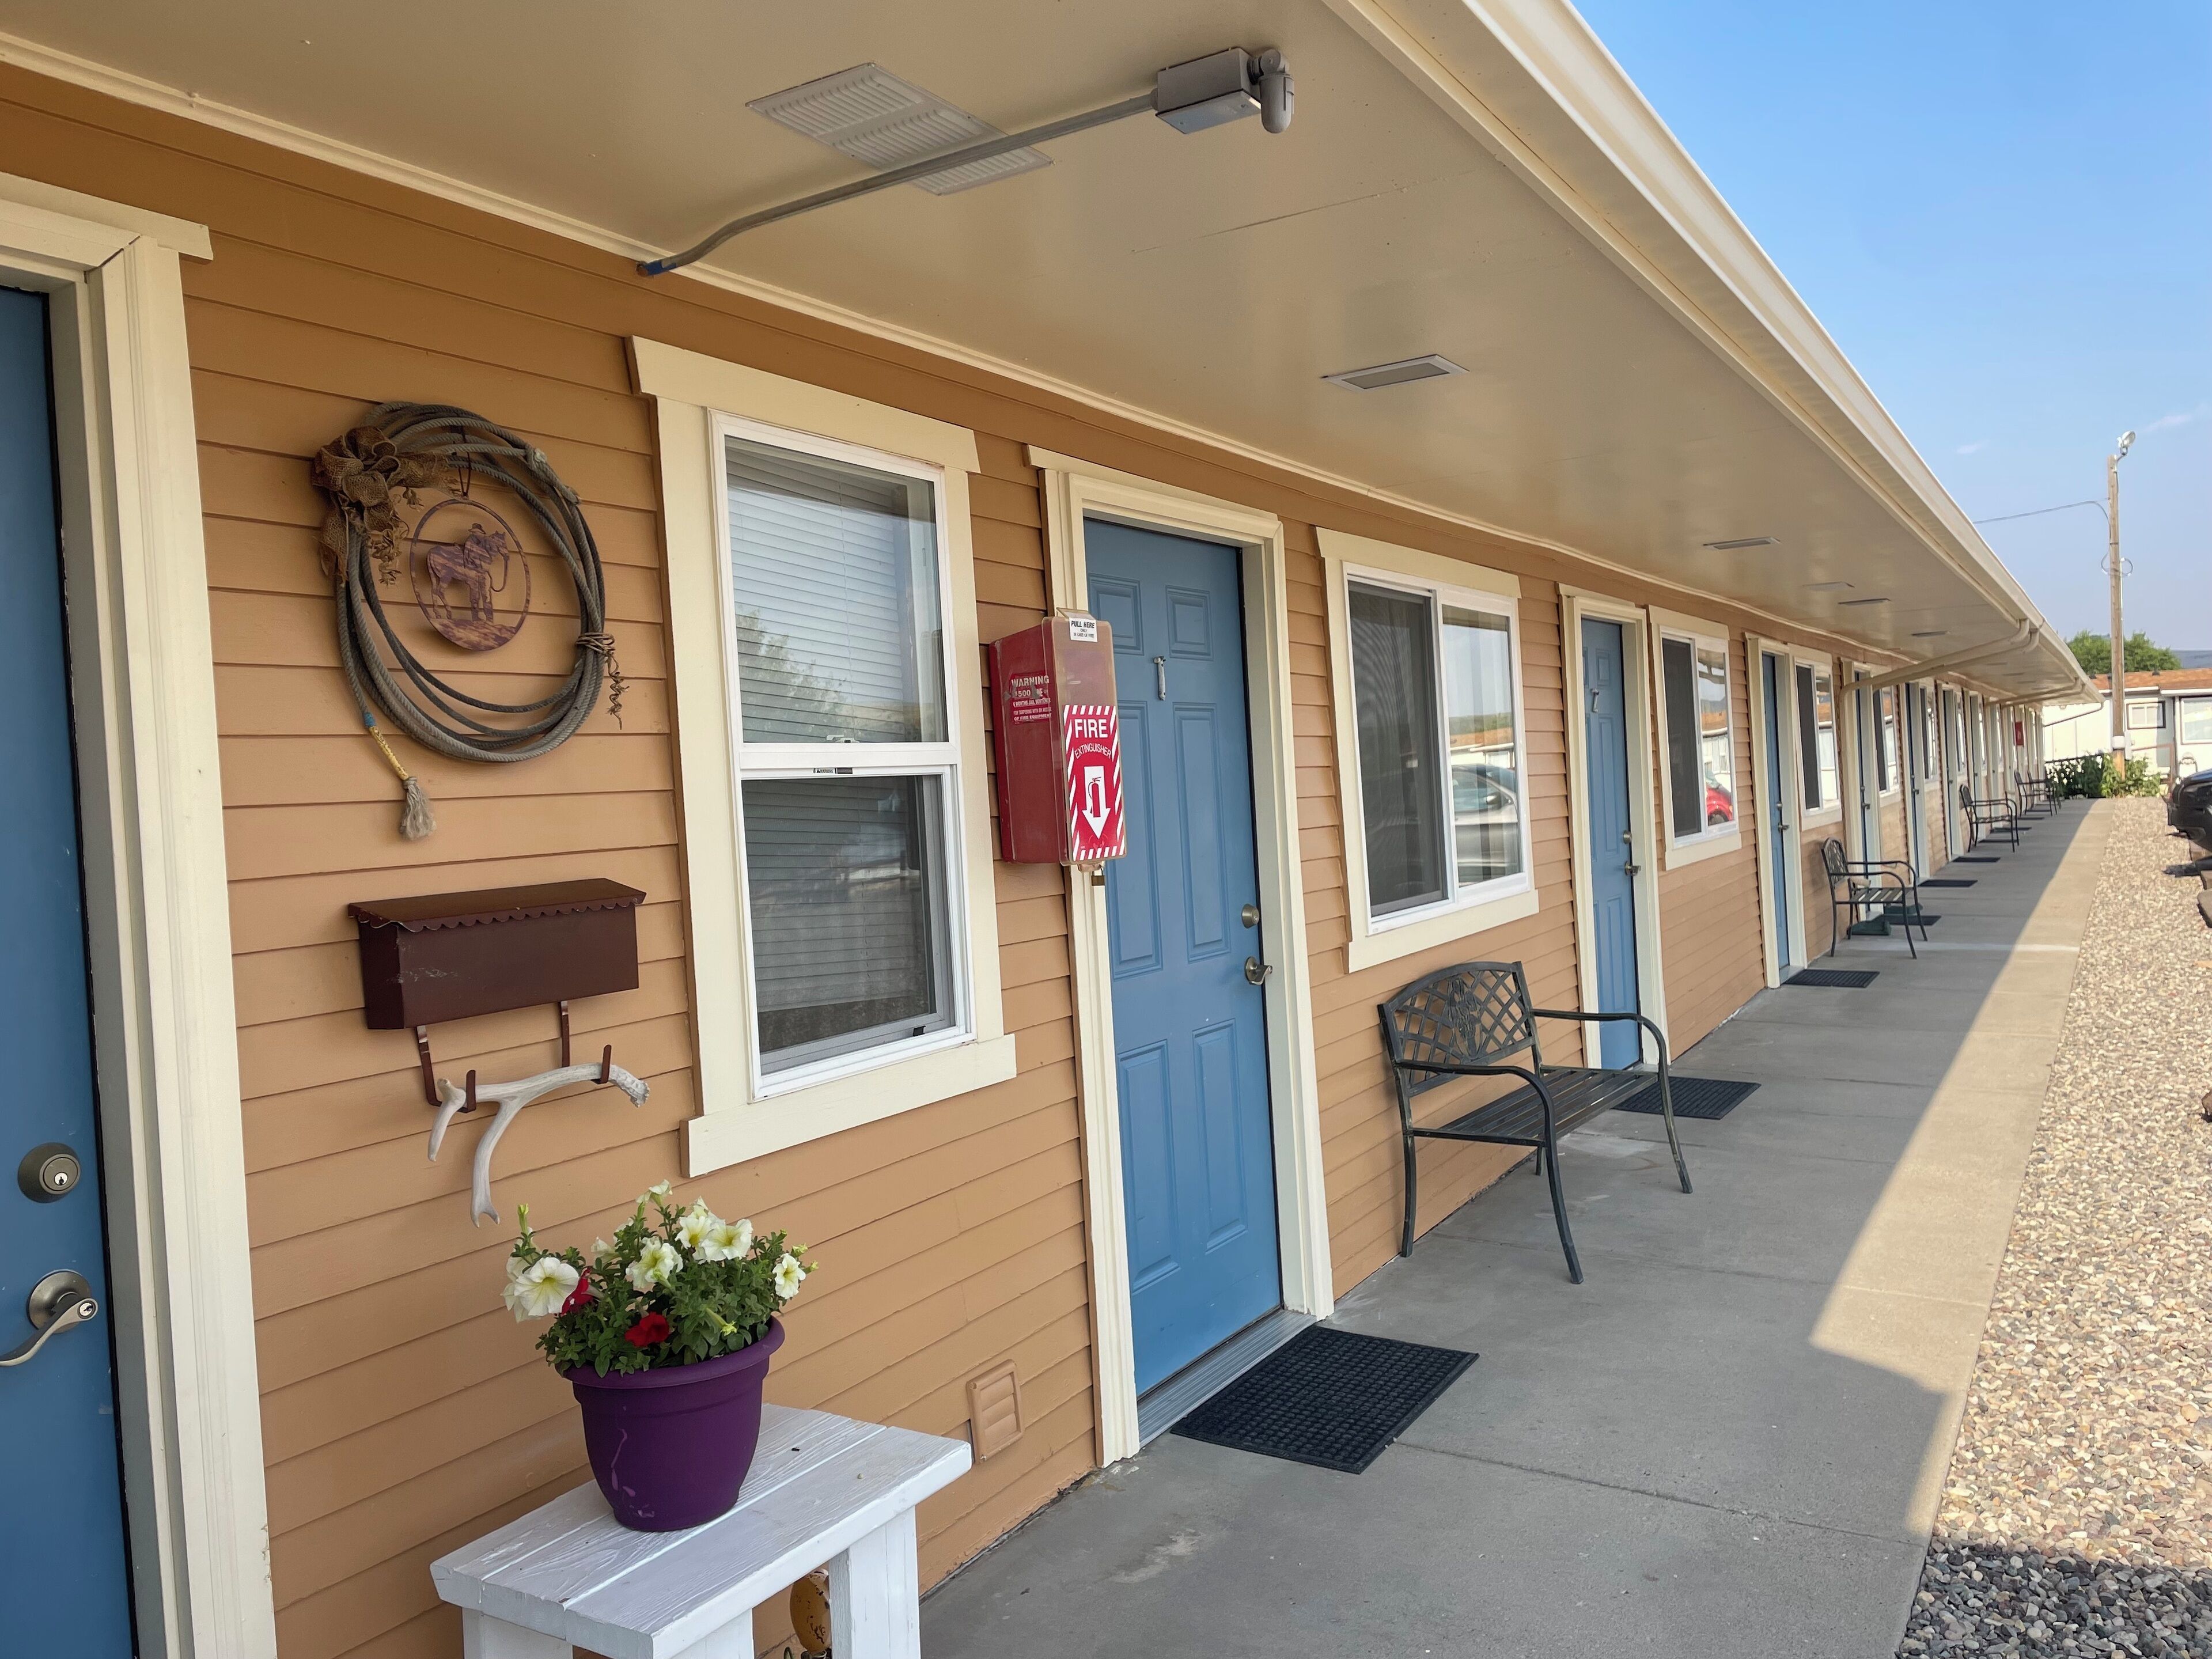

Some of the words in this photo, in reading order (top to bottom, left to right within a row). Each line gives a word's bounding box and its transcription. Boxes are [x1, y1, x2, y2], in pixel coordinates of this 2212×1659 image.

[1011, 675, 1050, 687] WARNING
[1074, 719, 1108, 738] FIRE
[1074, 743, 1111, 759] EXTINGUISHER
